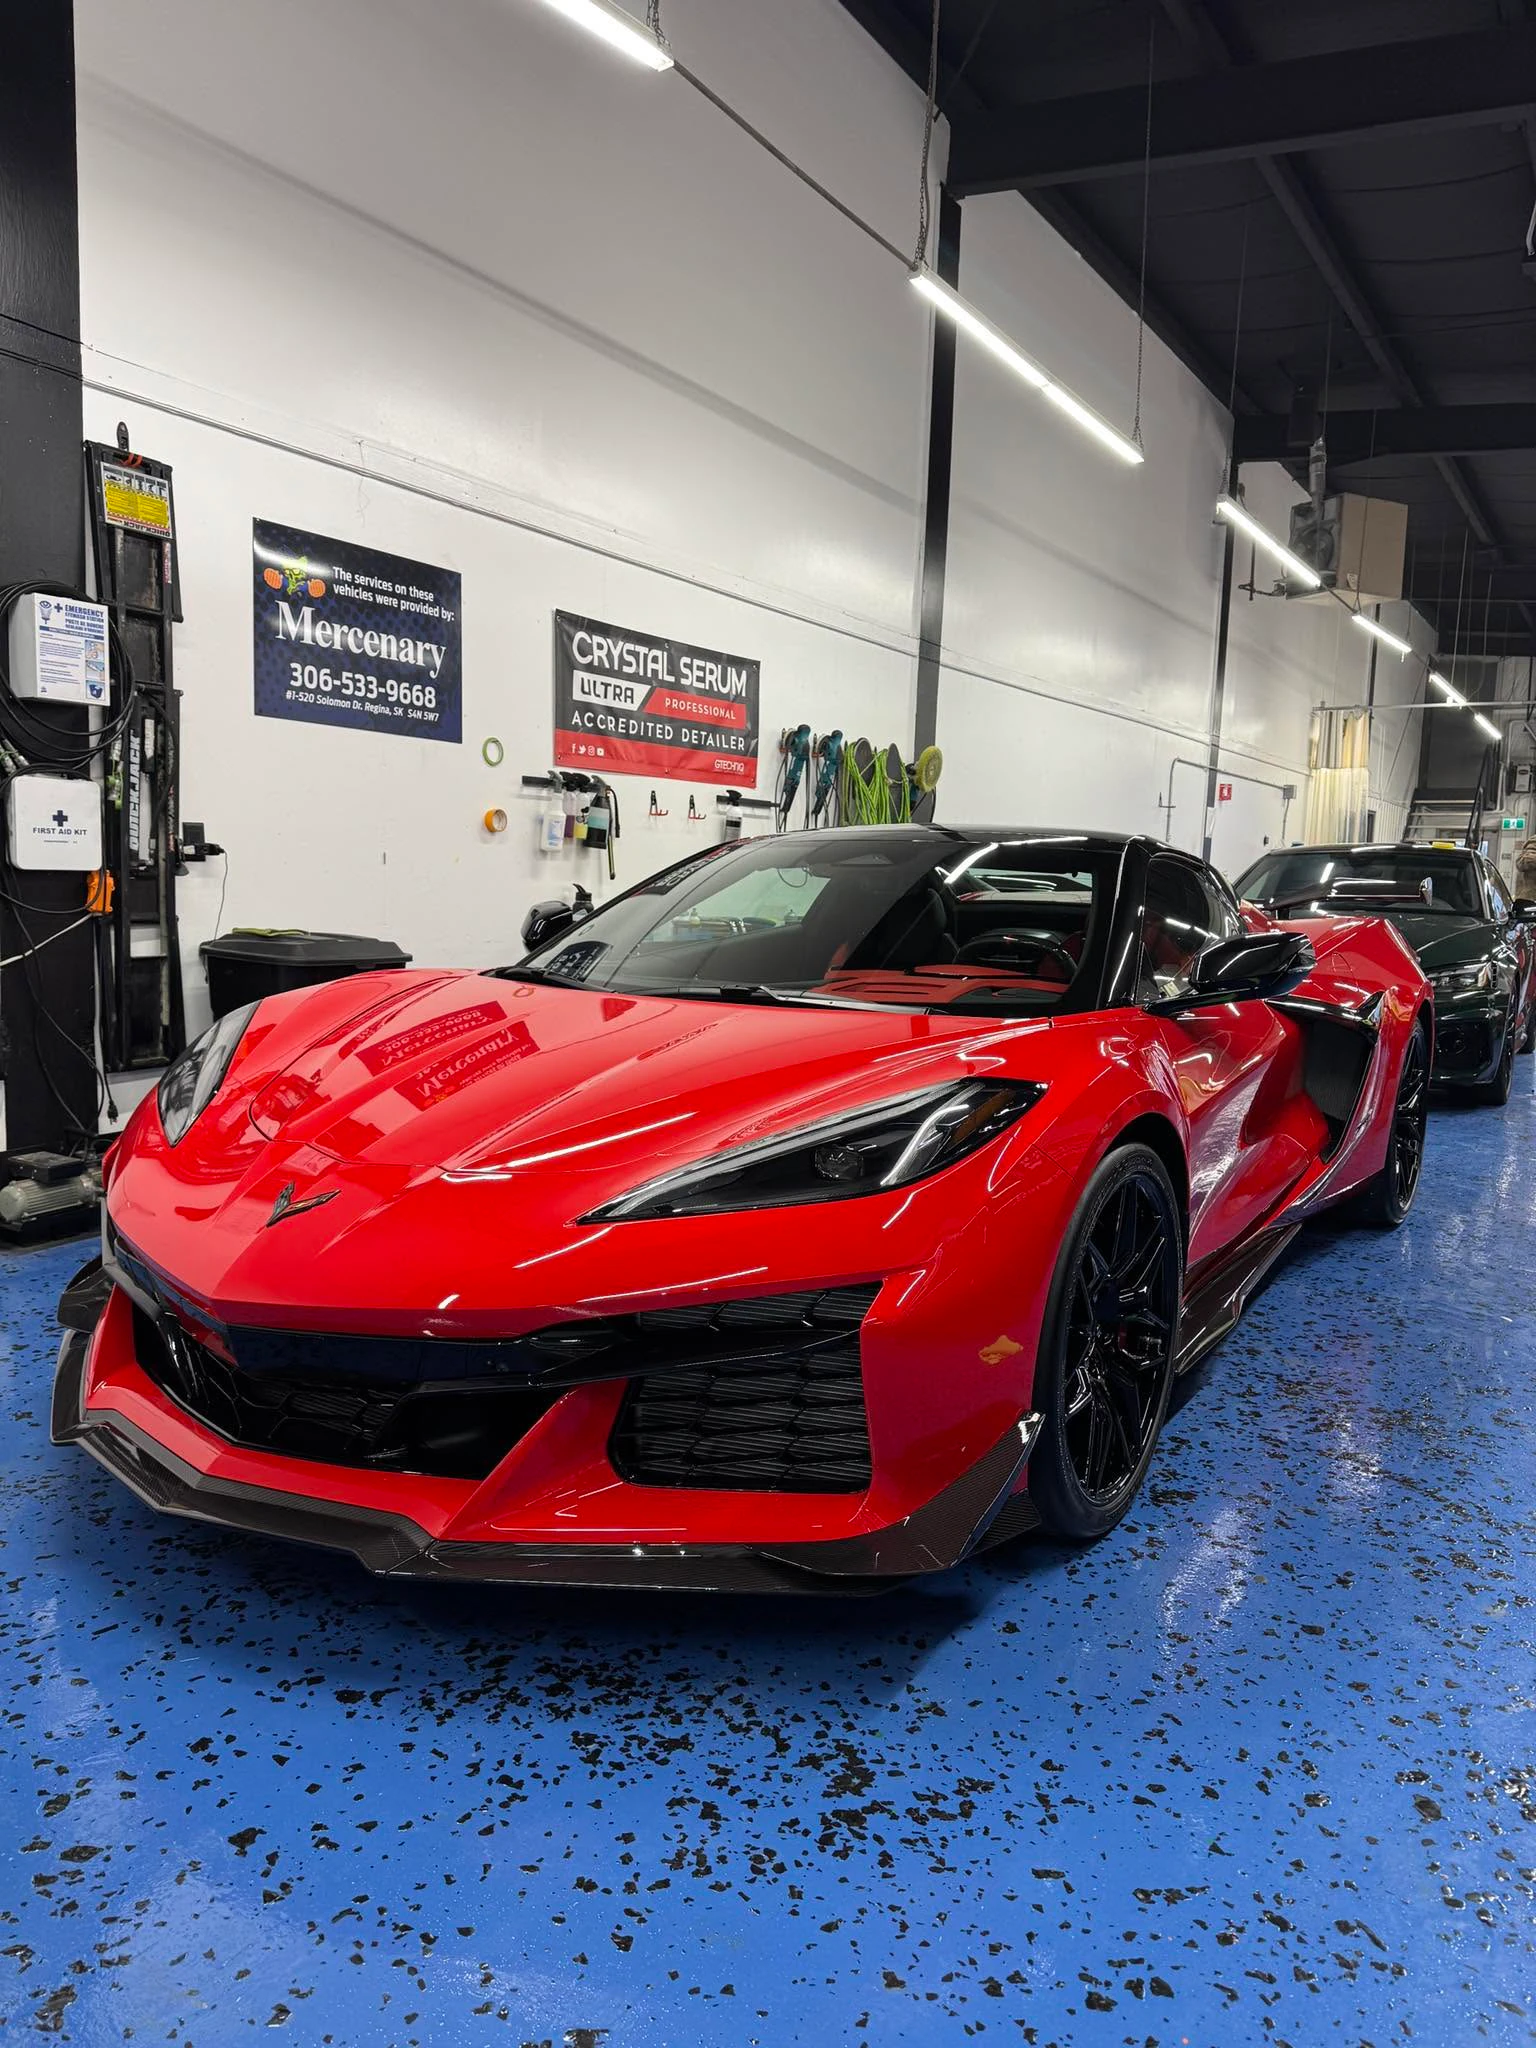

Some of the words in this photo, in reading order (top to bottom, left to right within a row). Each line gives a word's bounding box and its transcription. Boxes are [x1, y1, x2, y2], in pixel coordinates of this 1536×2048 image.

[333, 566, 352, 582] The
[354, 574, 393, 592] services
[394, 584, 407, 596] on
[408, 586, 434, 602] these
[333, 583, 373, 602] vehicles
[375, 593, 398, 608] were
[400, 600, 439, 617] provided
[441, 607, 455, 622] by:
[65, 604, 104, 618] EMERGENCY
[275, 600, 447, 679] Mercenary
[572, 631, 676, 683] CRYSTAL
[679, 656, 747, 697] SERUM
[290, 662, 436, 709] 306-533-9668
[580, 676, 634, 705] ULTRA
[286, 689, 315, 703] #1-520
[316, 694, 351, 709] Solomon
[352, 700, 363, 710] Dr.
[364, 702, 392, 717] Regina,
[394, 708, 404, 717] SK
[407, 709, 423, 719] S4N
[424, 712, 440, 722] 5W7
[664, 697, 736, 720] PROFESSIONAL
[571, 711, 674, 740] ACCREDITED
[681, 731, 745, 751] DETAILER
[129, 735, 141, 851] QUICKJACK
